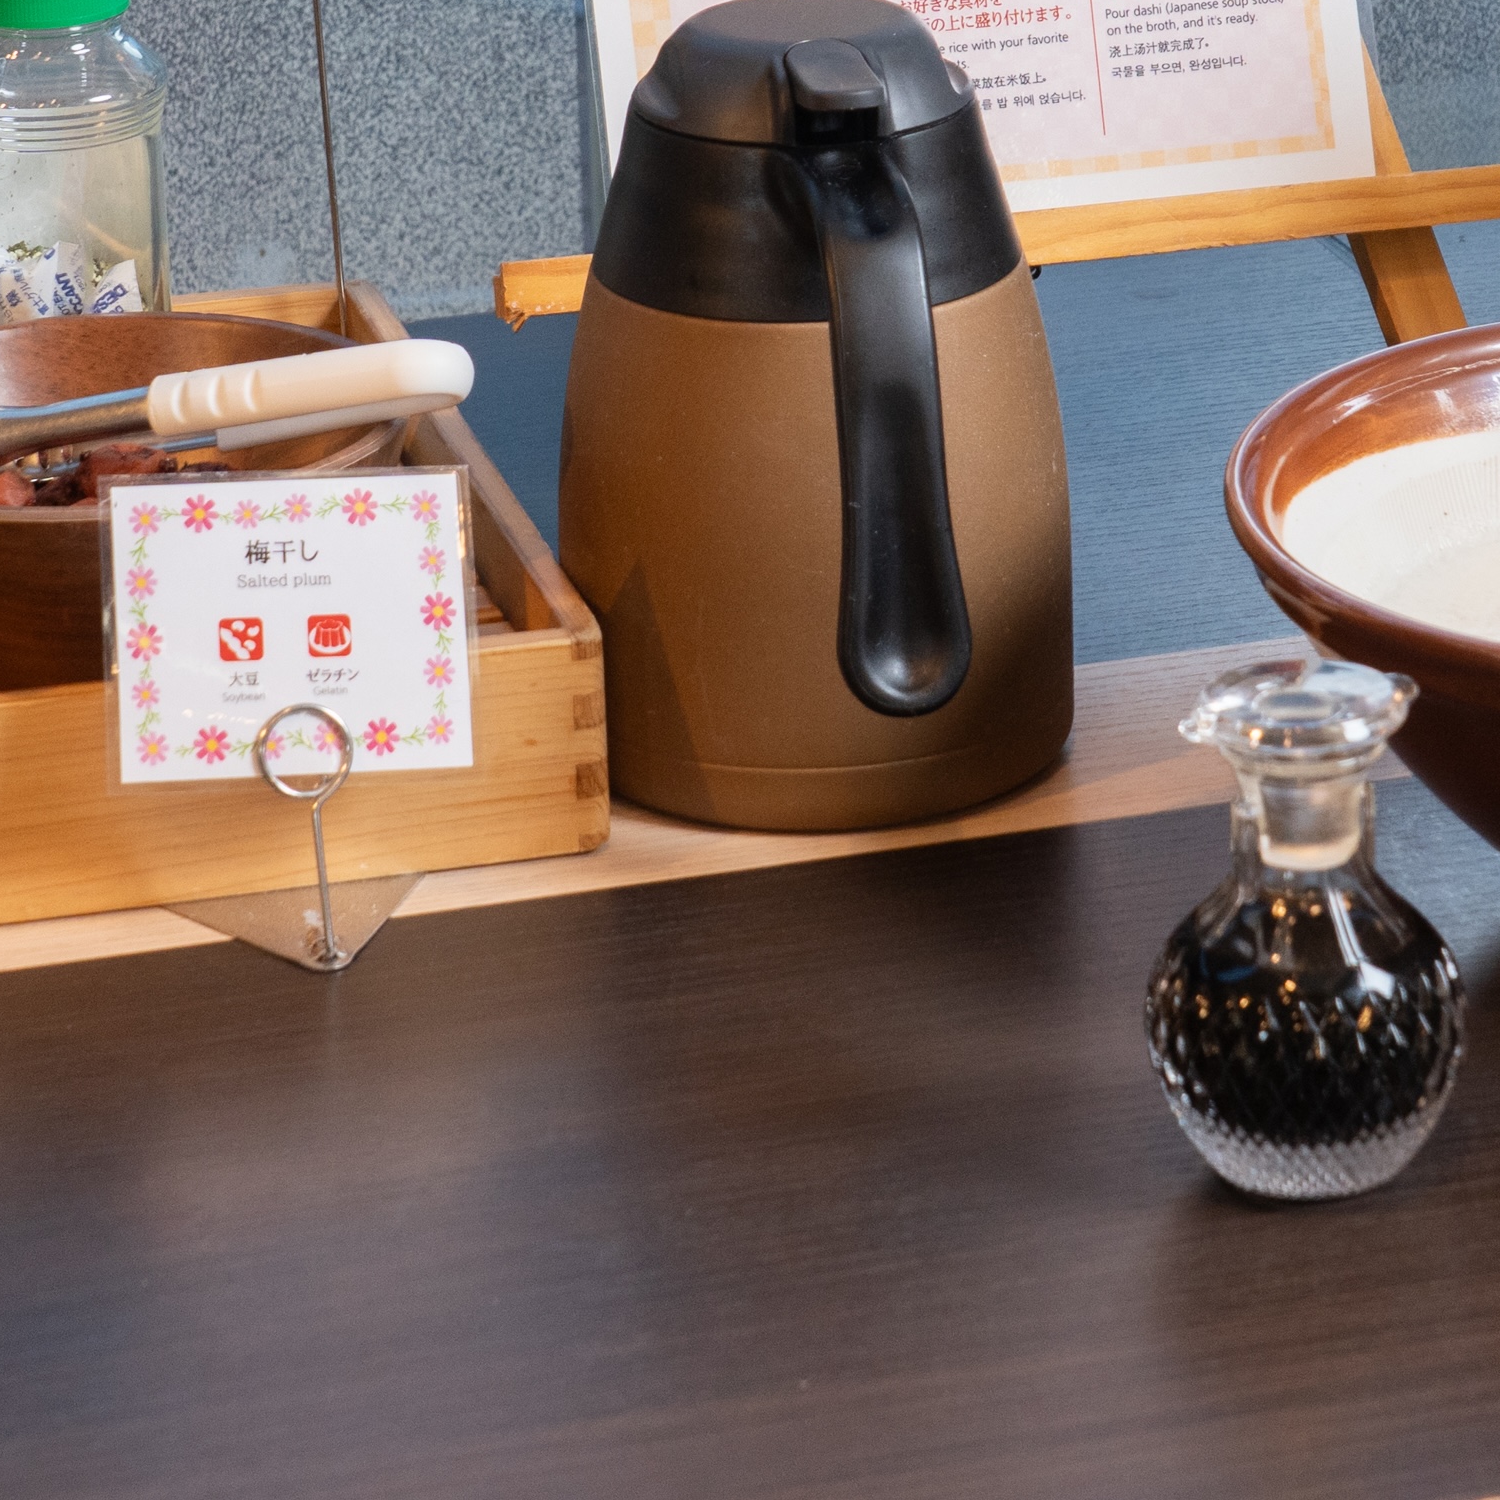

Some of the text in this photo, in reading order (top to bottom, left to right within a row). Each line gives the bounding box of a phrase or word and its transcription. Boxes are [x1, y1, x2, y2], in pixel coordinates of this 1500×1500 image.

[1105, 8, 1130, 19] Pour
[1134, 3, 1162, 16] dashi
[1165, 0, 1219, 15] (Japanese
[1106, 11, 1259, 36] on the broth, and it's ready.
[949, 41, 968, 54] rice
[971, 38, 996, 52] with
[999, 36, 1023, 51] your
[1027, 32, 1069, 46] favorite
[244, 539, 319, 566] 梅干し
[236, 572, 332, 589] Salted plum
[228, 670, 260, 687] 大豆
[306, 667, 360, 683] ゼラチン
